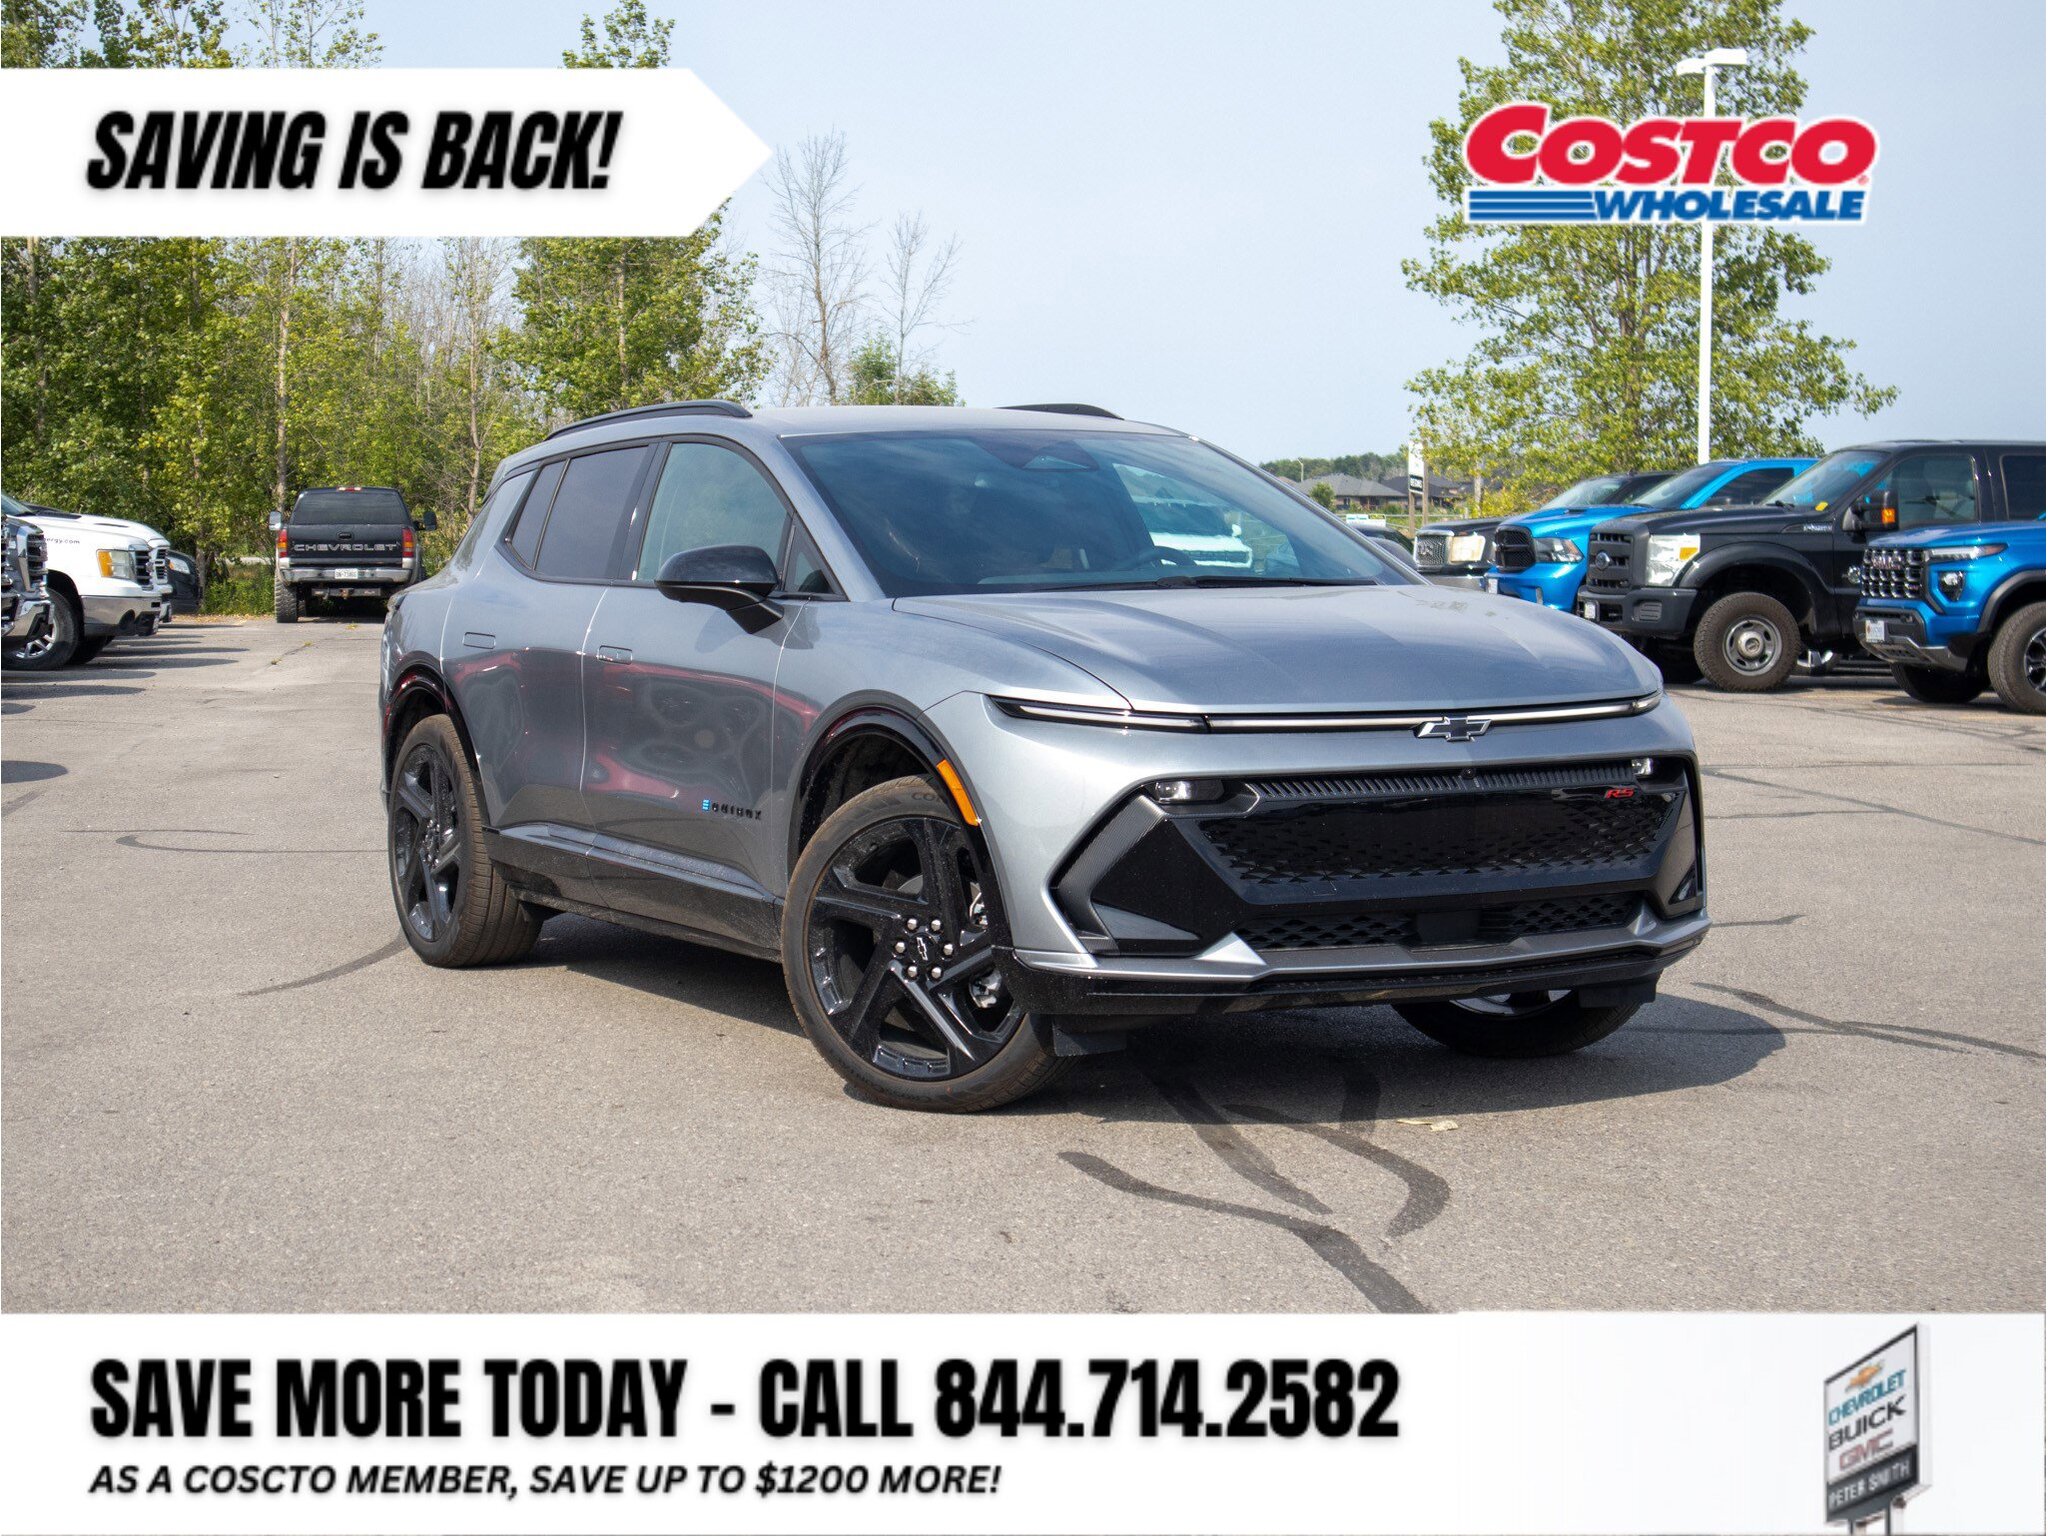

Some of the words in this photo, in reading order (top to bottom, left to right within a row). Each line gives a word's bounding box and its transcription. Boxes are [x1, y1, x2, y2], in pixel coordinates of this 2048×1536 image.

[294, 543, 397, 552] CHEVROLET
[1604, 787, 1635, 799] RS
[701, 799, 762, 820] EQUINOX
